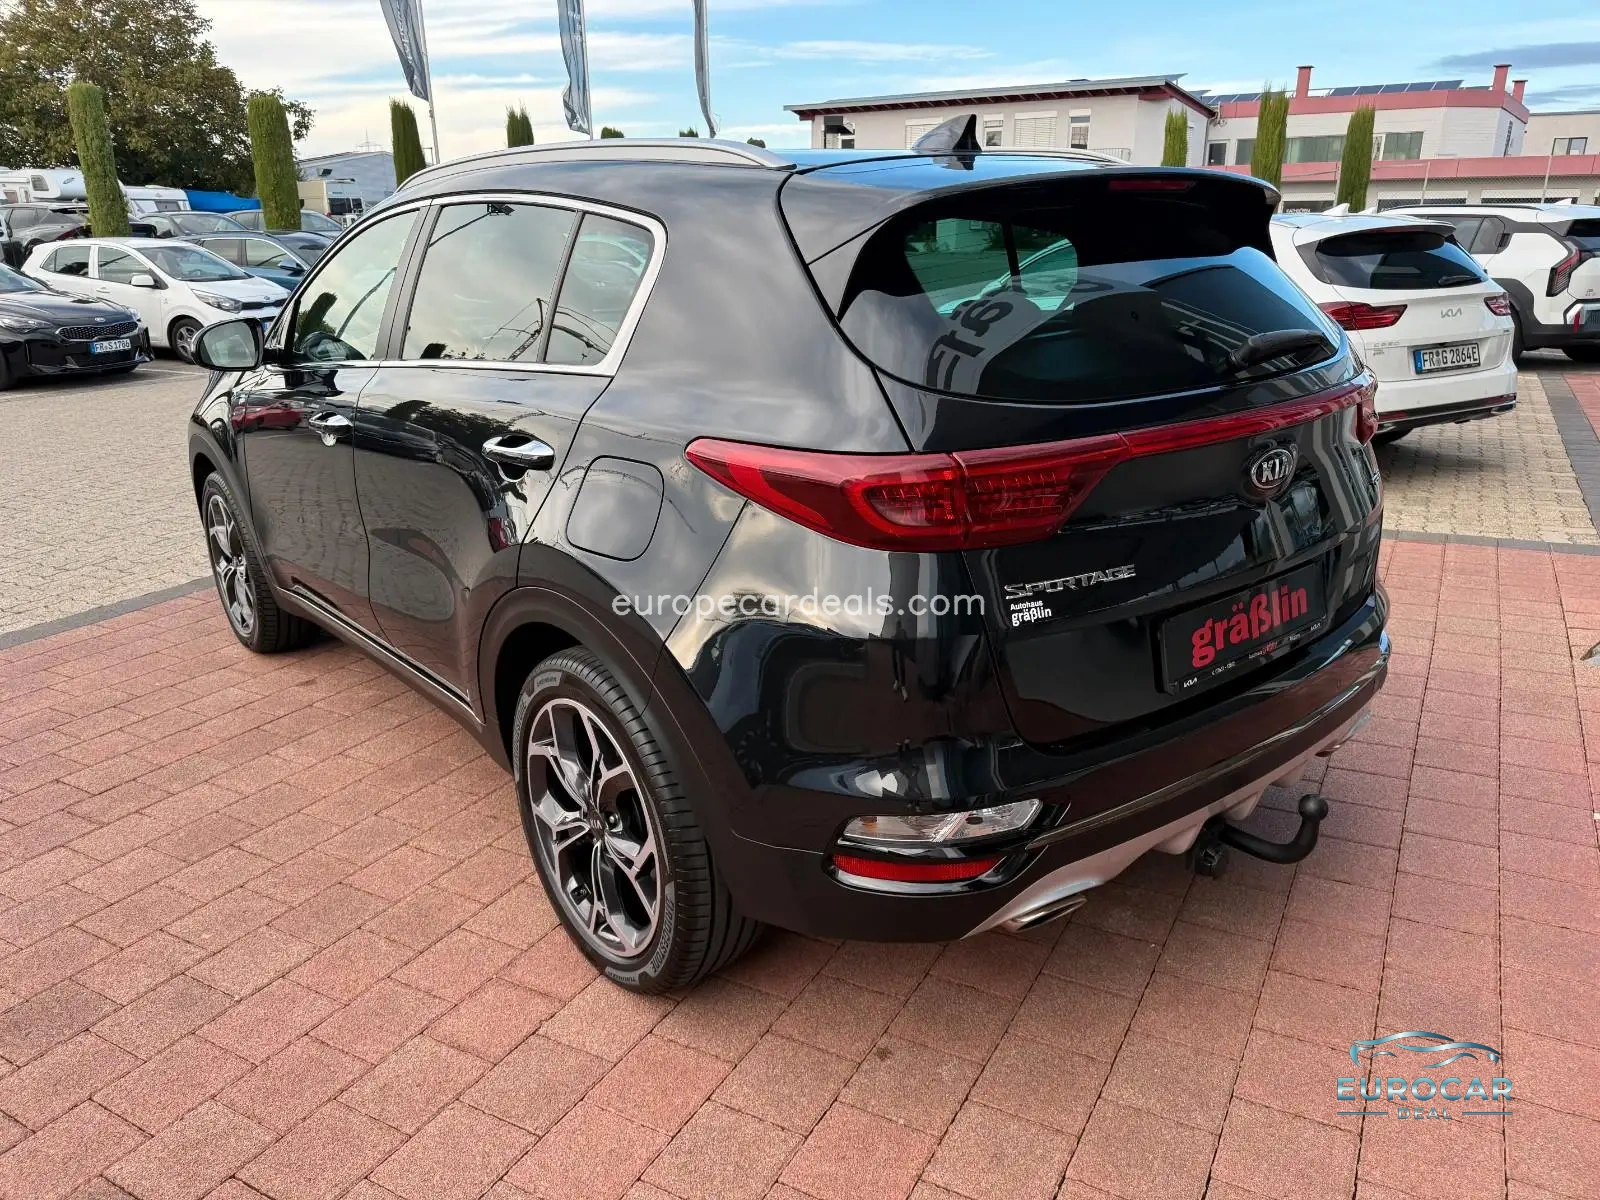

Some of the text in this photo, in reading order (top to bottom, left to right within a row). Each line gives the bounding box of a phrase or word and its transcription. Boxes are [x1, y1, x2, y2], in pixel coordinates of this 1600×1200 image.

[1422, 351, 1436, 368] FR
[1261, 455, 1289, 483] KIA
[1004, 564, 1137, 600] SPORTAGE
[1010, 600, 1043, 611] Autohaus
[1011, 606, 1052, 627] gräßlin
[1191, 585, 1308, 669] gräßlin
